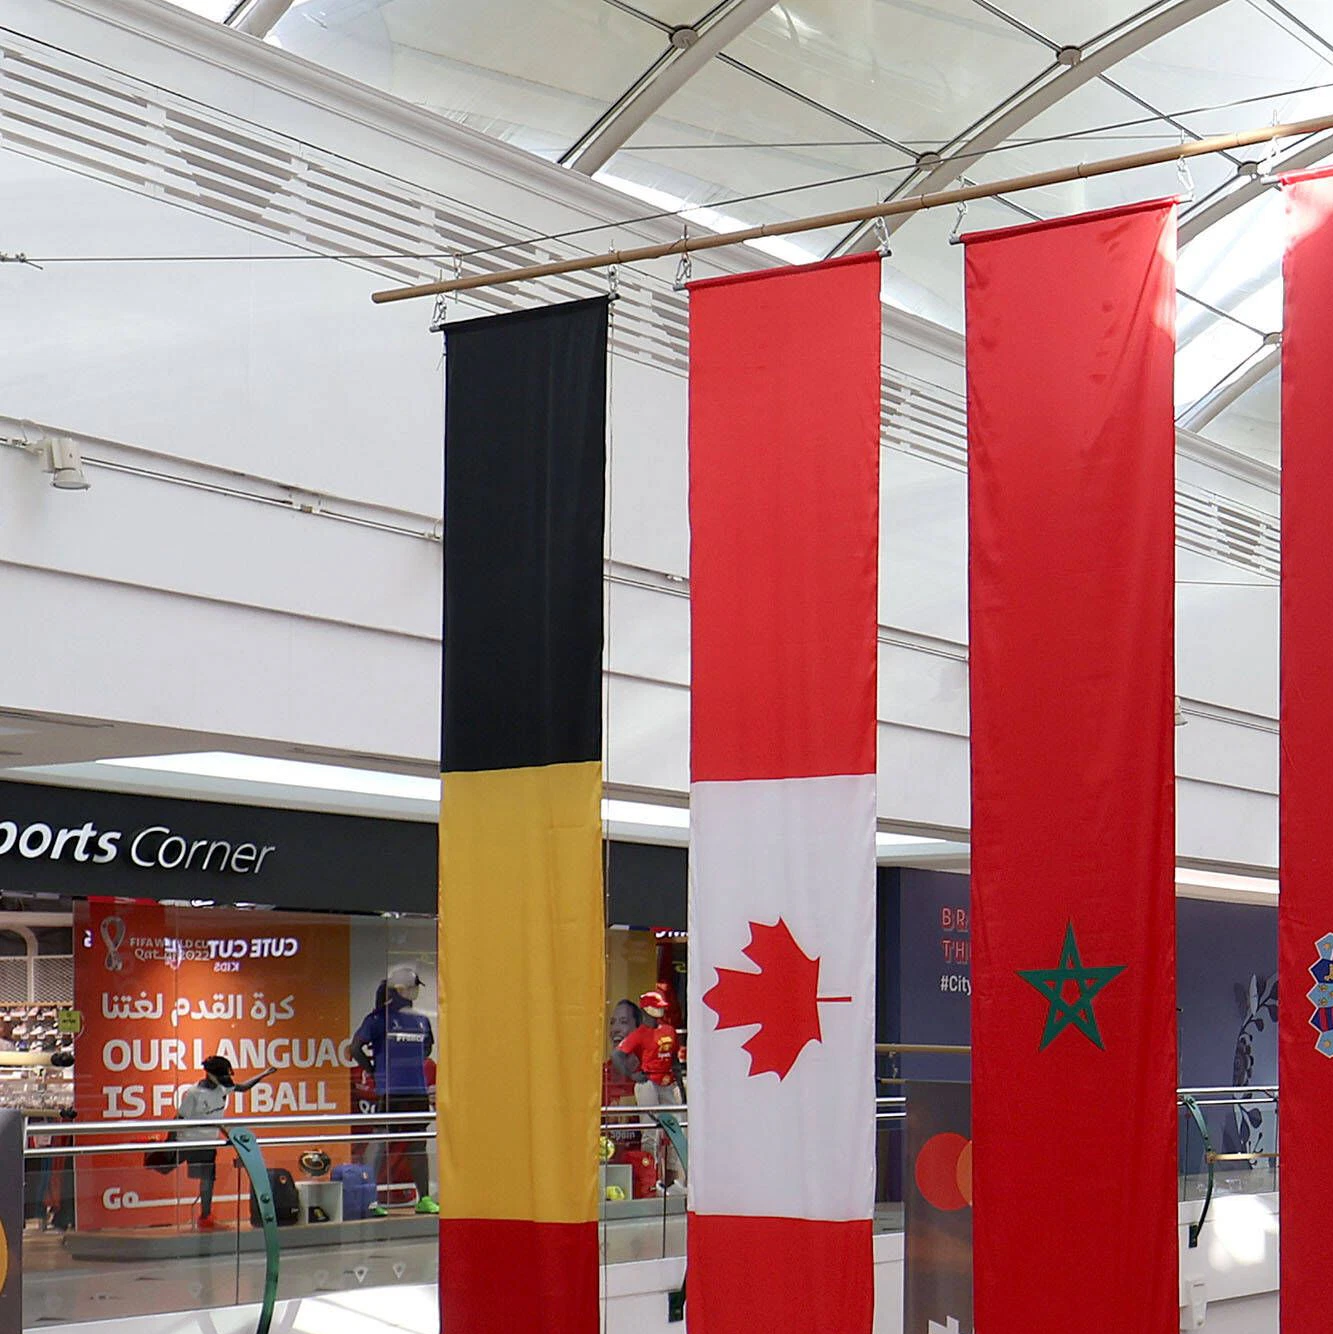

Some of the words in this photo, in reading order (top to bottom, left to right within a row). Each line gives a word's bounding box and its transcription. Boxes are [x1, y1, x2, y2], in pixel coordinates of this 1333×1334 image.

[131, 826, 276, 874] Corner
[101, 993, 164, 1020] لغتنا
[170, 993, 243, 1027] القدم
[250, 992, 296, 1027] كرة
[102, 1038, 187, 1072] OUR
[102, 1085, 147, 1119] IS
[103, 1187, 141, 1210] Go
